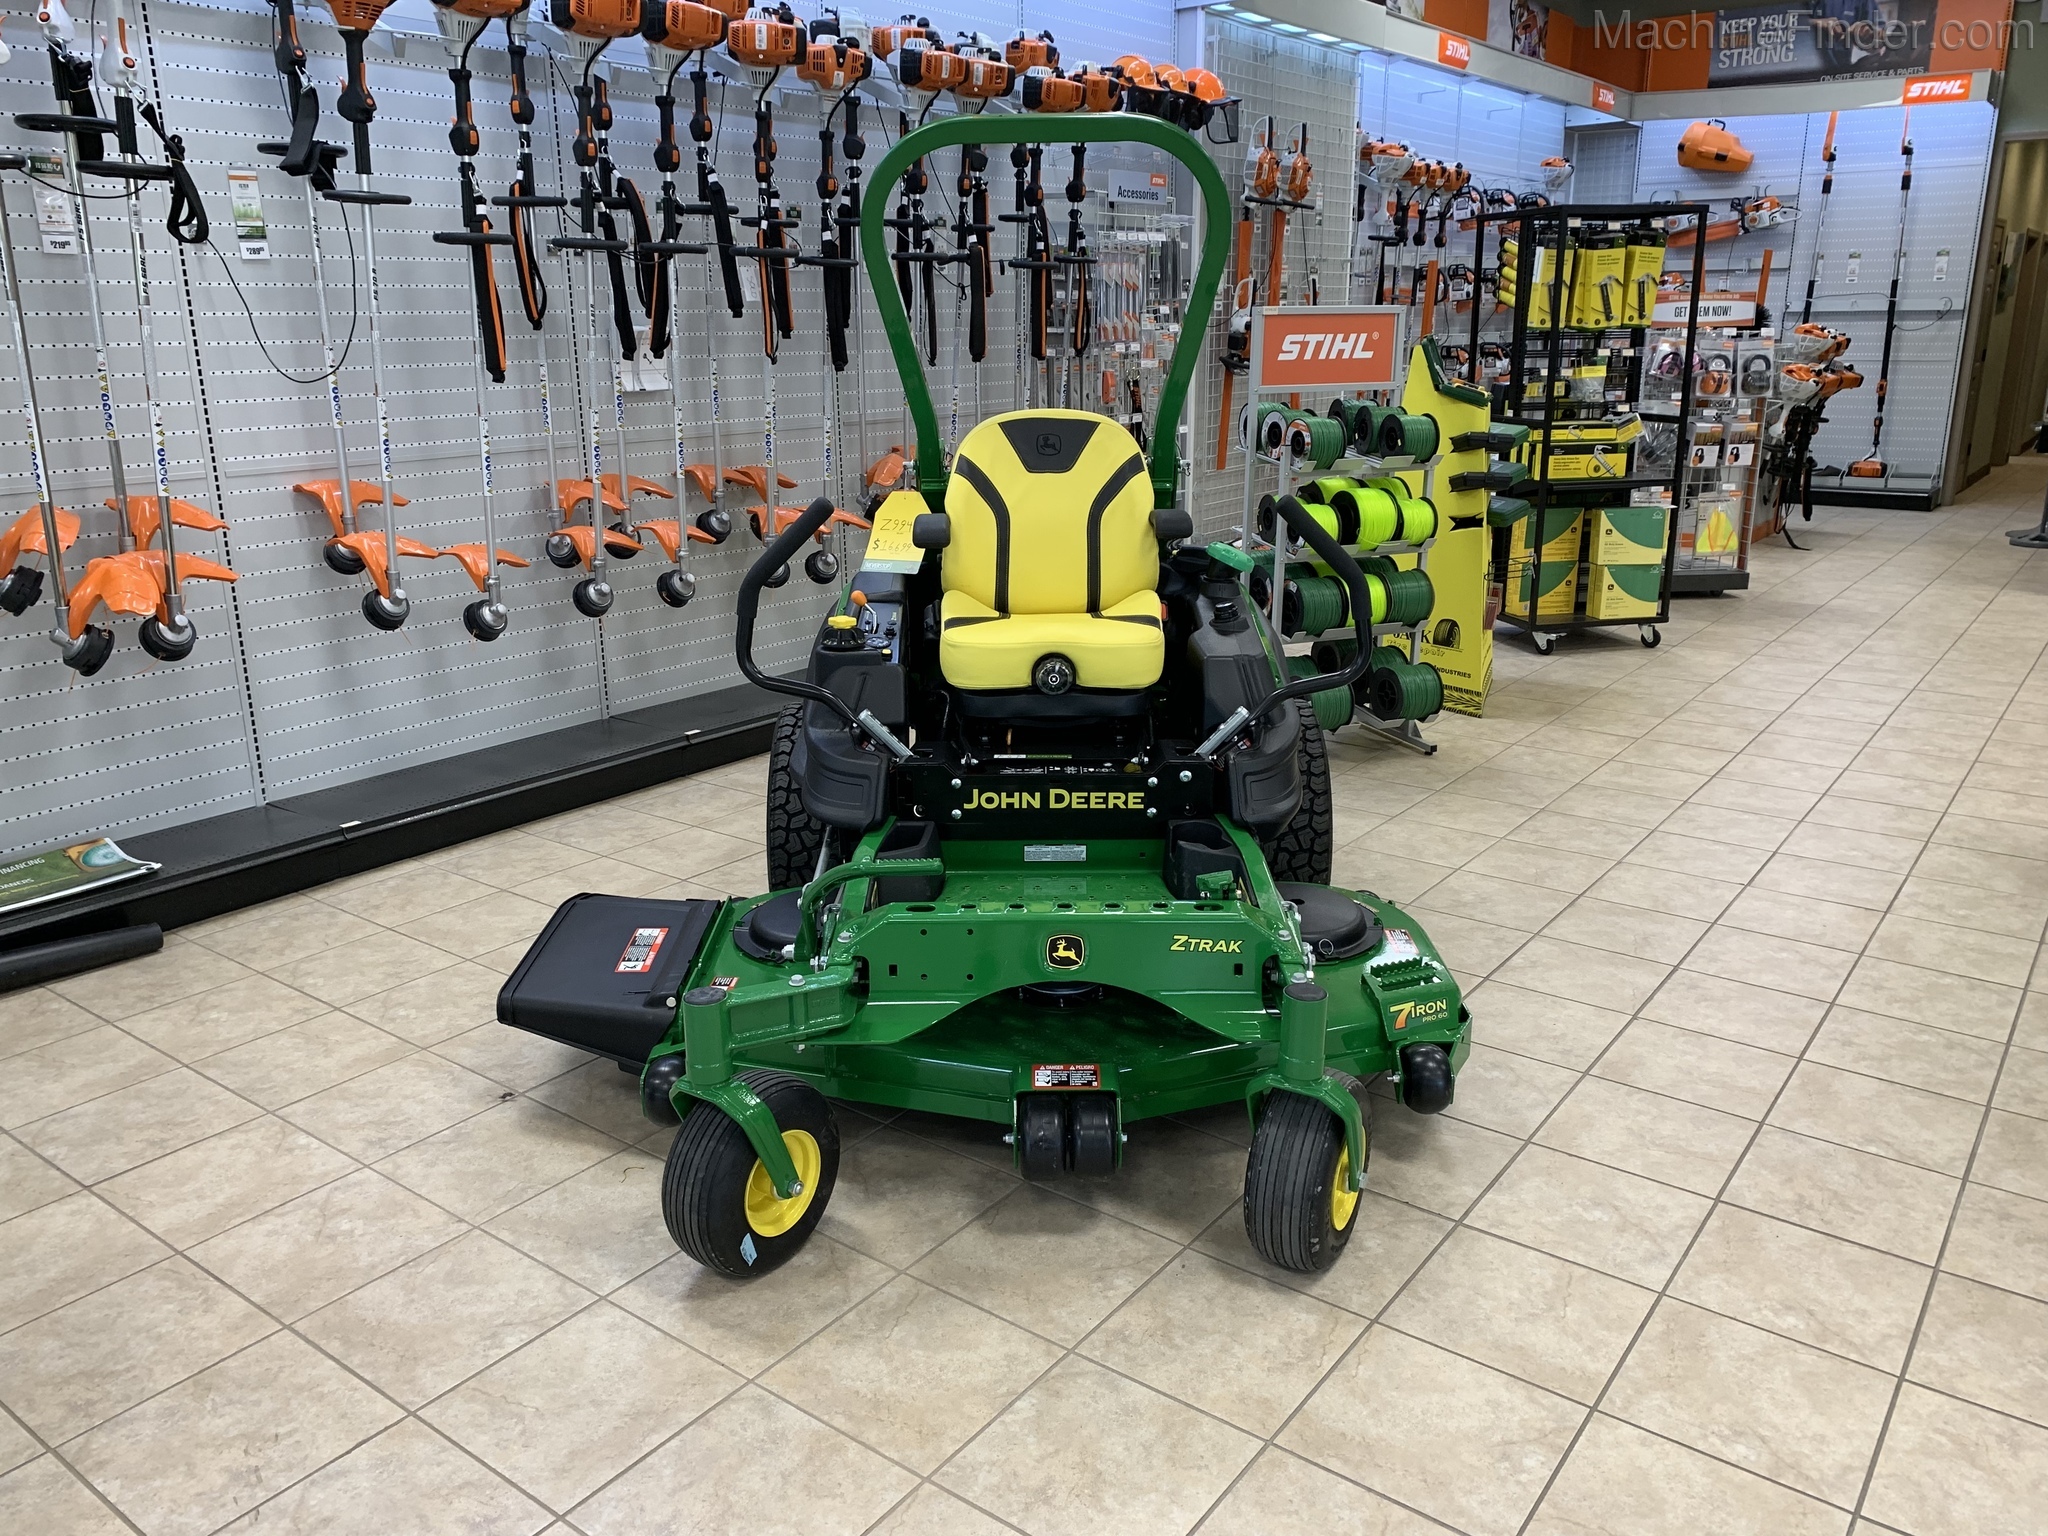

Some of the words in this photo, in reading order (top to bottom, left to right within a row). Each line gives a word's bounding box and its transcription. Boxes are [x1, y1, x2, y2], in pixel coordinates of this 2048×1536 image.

[1722, 18, 1757, 34] KEEP
[1761, 13, 1798, 29] YOUR
[1758, 29, 1796, 45] GOING
[1446, 40, 1470, 61] STIHL
[1853, 69, 1887, 79] SERVICE
[1598, 88, 1615, 105] STIHL
[1907, 80, 1966, 97] STIHL
[1118, 185, 1158, 200] Accessories
[1674, 306, 1688, 318] GET
[1712, 306, 1732, 316] NOW!
[1277, 333, 1374, 361] STIHL
[880, 518, 912, 532] Z994
[1393, 630, 1431, 644] JAK
[1420, 646, 1446, 658] epair
[964, 788, 1040, 810] JOHN
[1049, 788, 1144, 809] DEERE
[0, 857, 46, 875] INANCING
[0, 878, 35, 890] OANERS
[1170, 935, 1244, 953] ZTRAK
[1422, 1014, 1436, 1023] PRO
